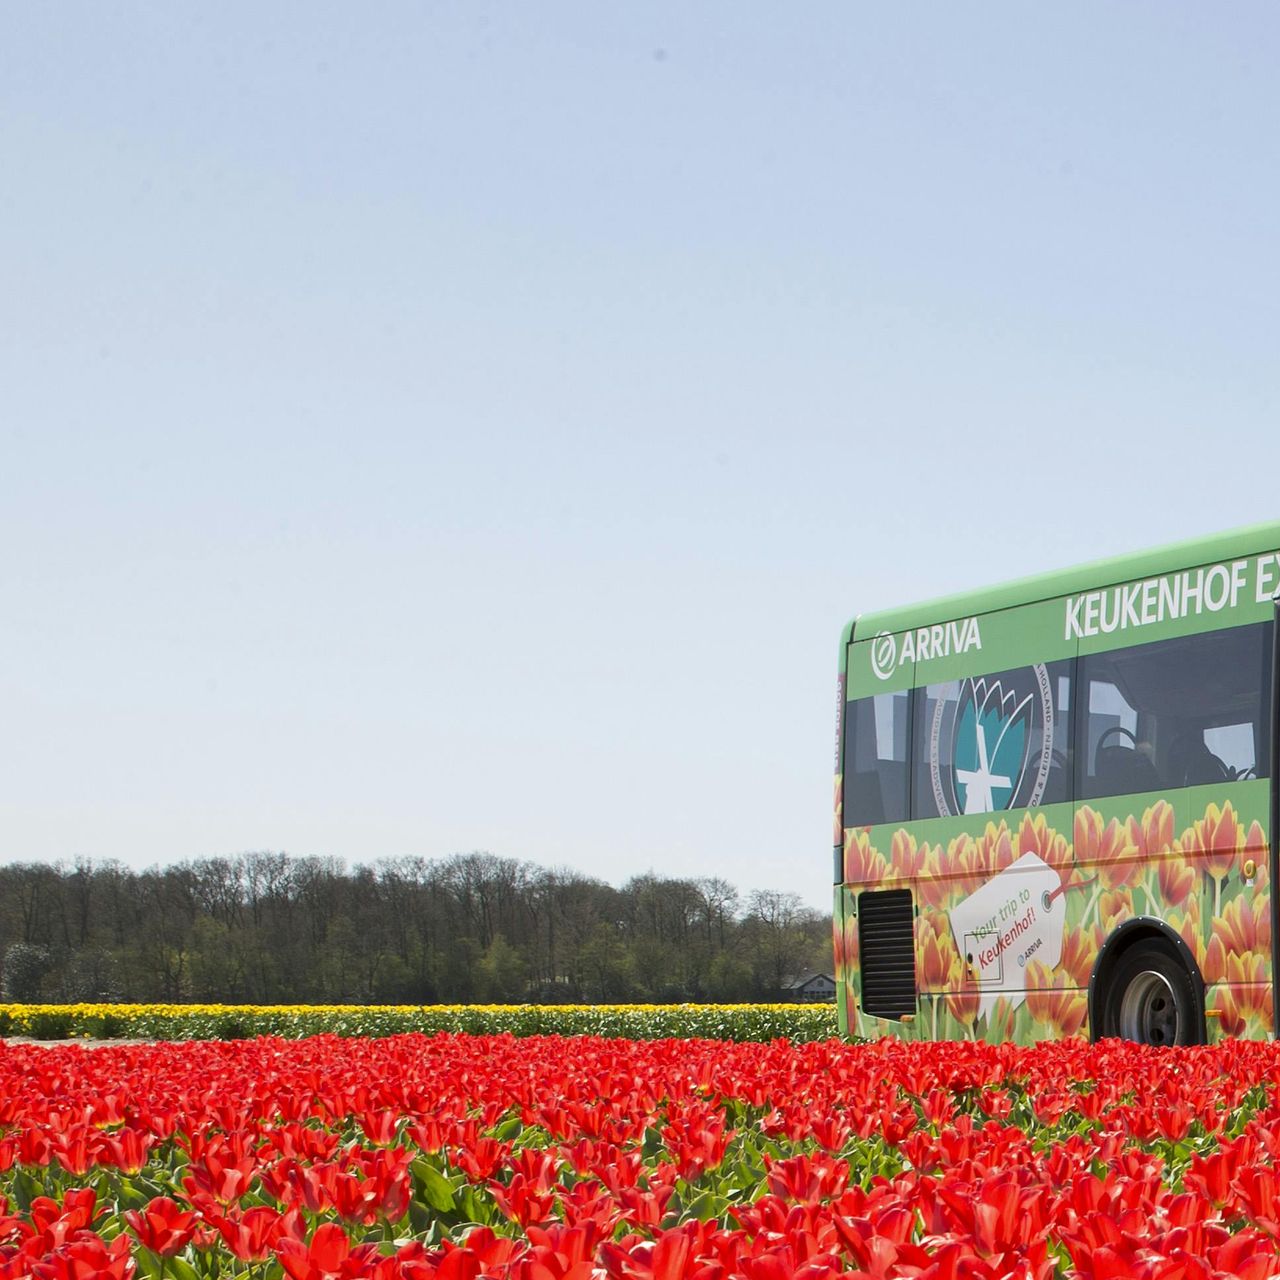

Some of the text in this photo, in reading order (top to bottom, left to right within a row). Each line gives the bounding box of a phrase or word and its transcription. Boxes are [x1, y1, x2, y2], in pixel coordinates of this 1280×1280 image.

[1064, 560, 1248, 641] KEUKENHOF
[899, 617, 982, 666] ARRIVA
[971, 888, 1031, 944] Your trip to
[978, 907, 1037, 970] Keukenhof!
